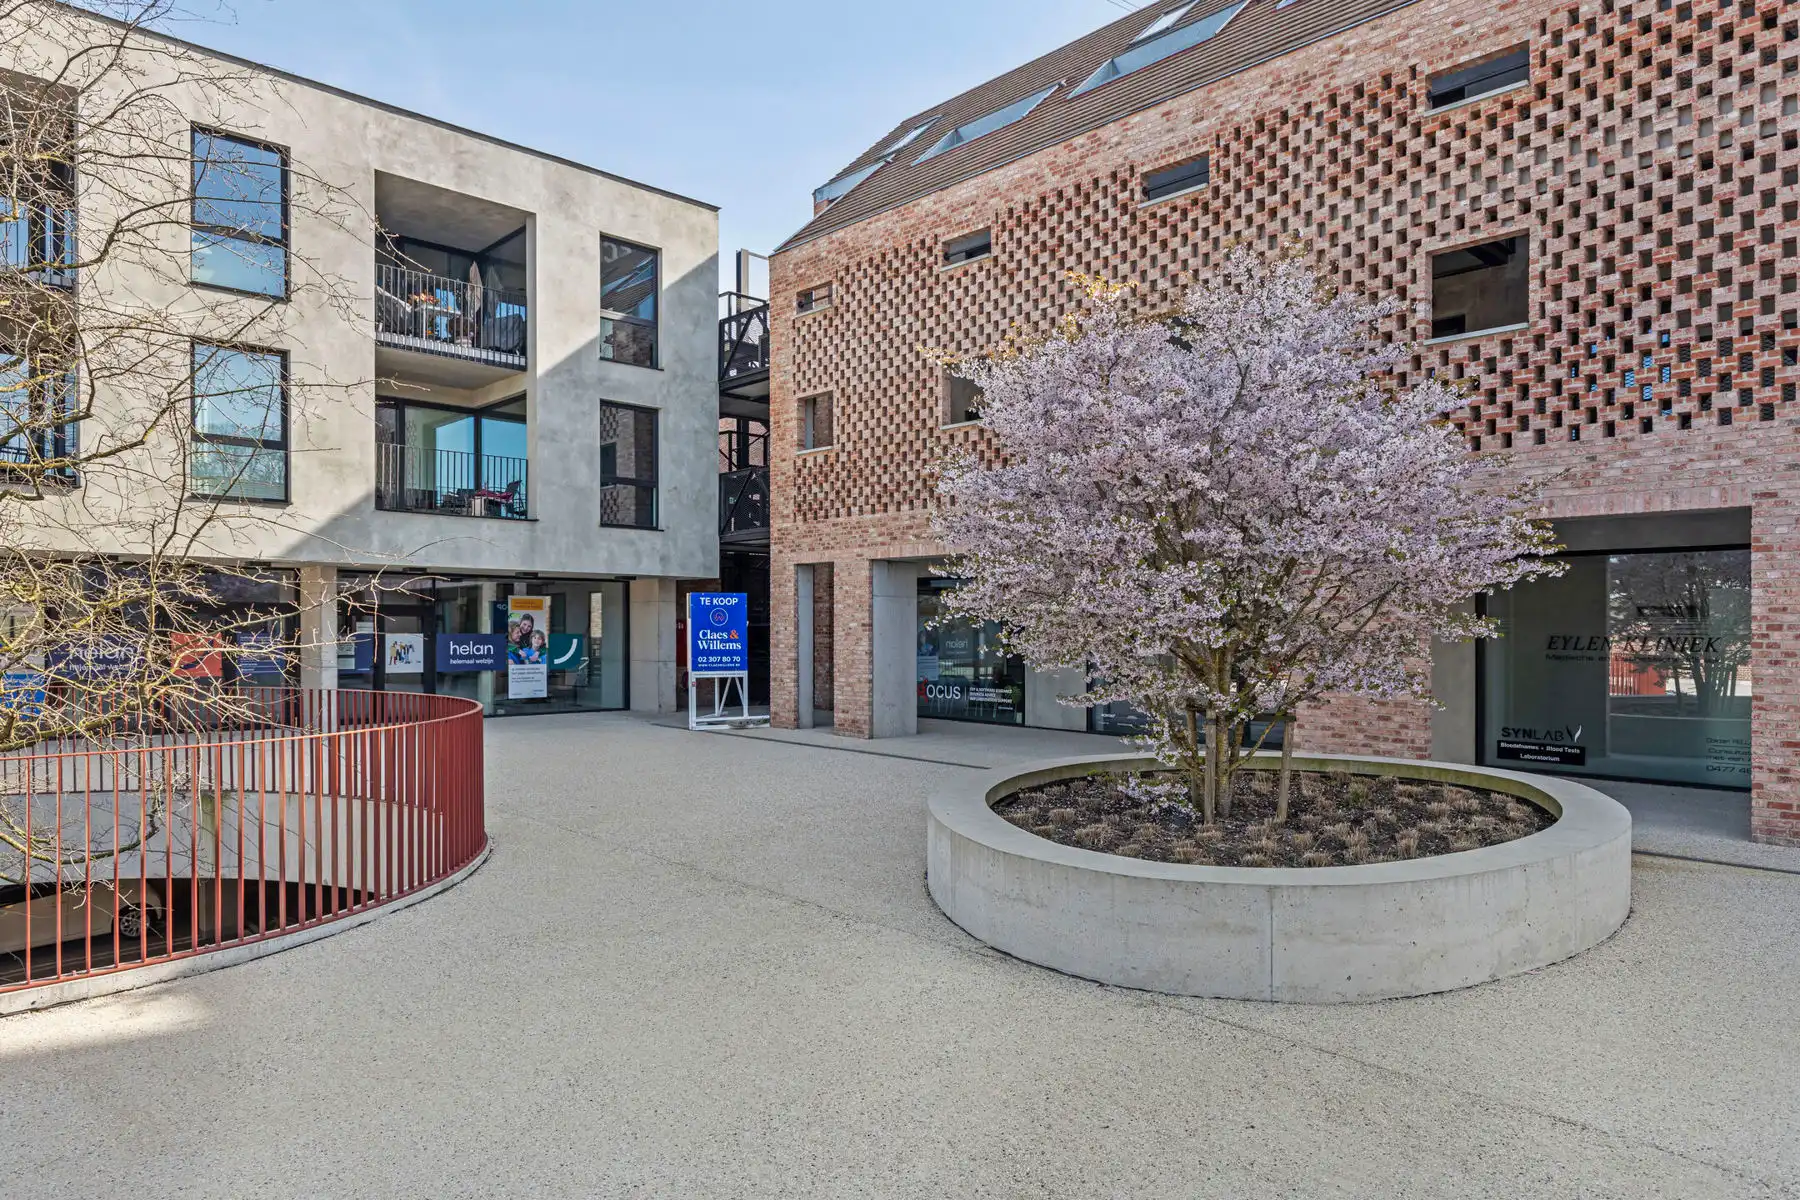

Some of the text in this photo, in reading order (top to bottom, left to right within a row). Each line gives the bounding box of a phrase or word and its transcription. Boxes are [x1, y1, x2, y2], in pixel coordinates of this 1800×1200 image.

[699, 597, 739, 606] TE KOOP
[699, 629, 739, 640] Claes &
[450, 640, 494, 655] helan
[697, 640, 742, 650] Willems
[1501, 726, 1565, 742] SYNLAB
